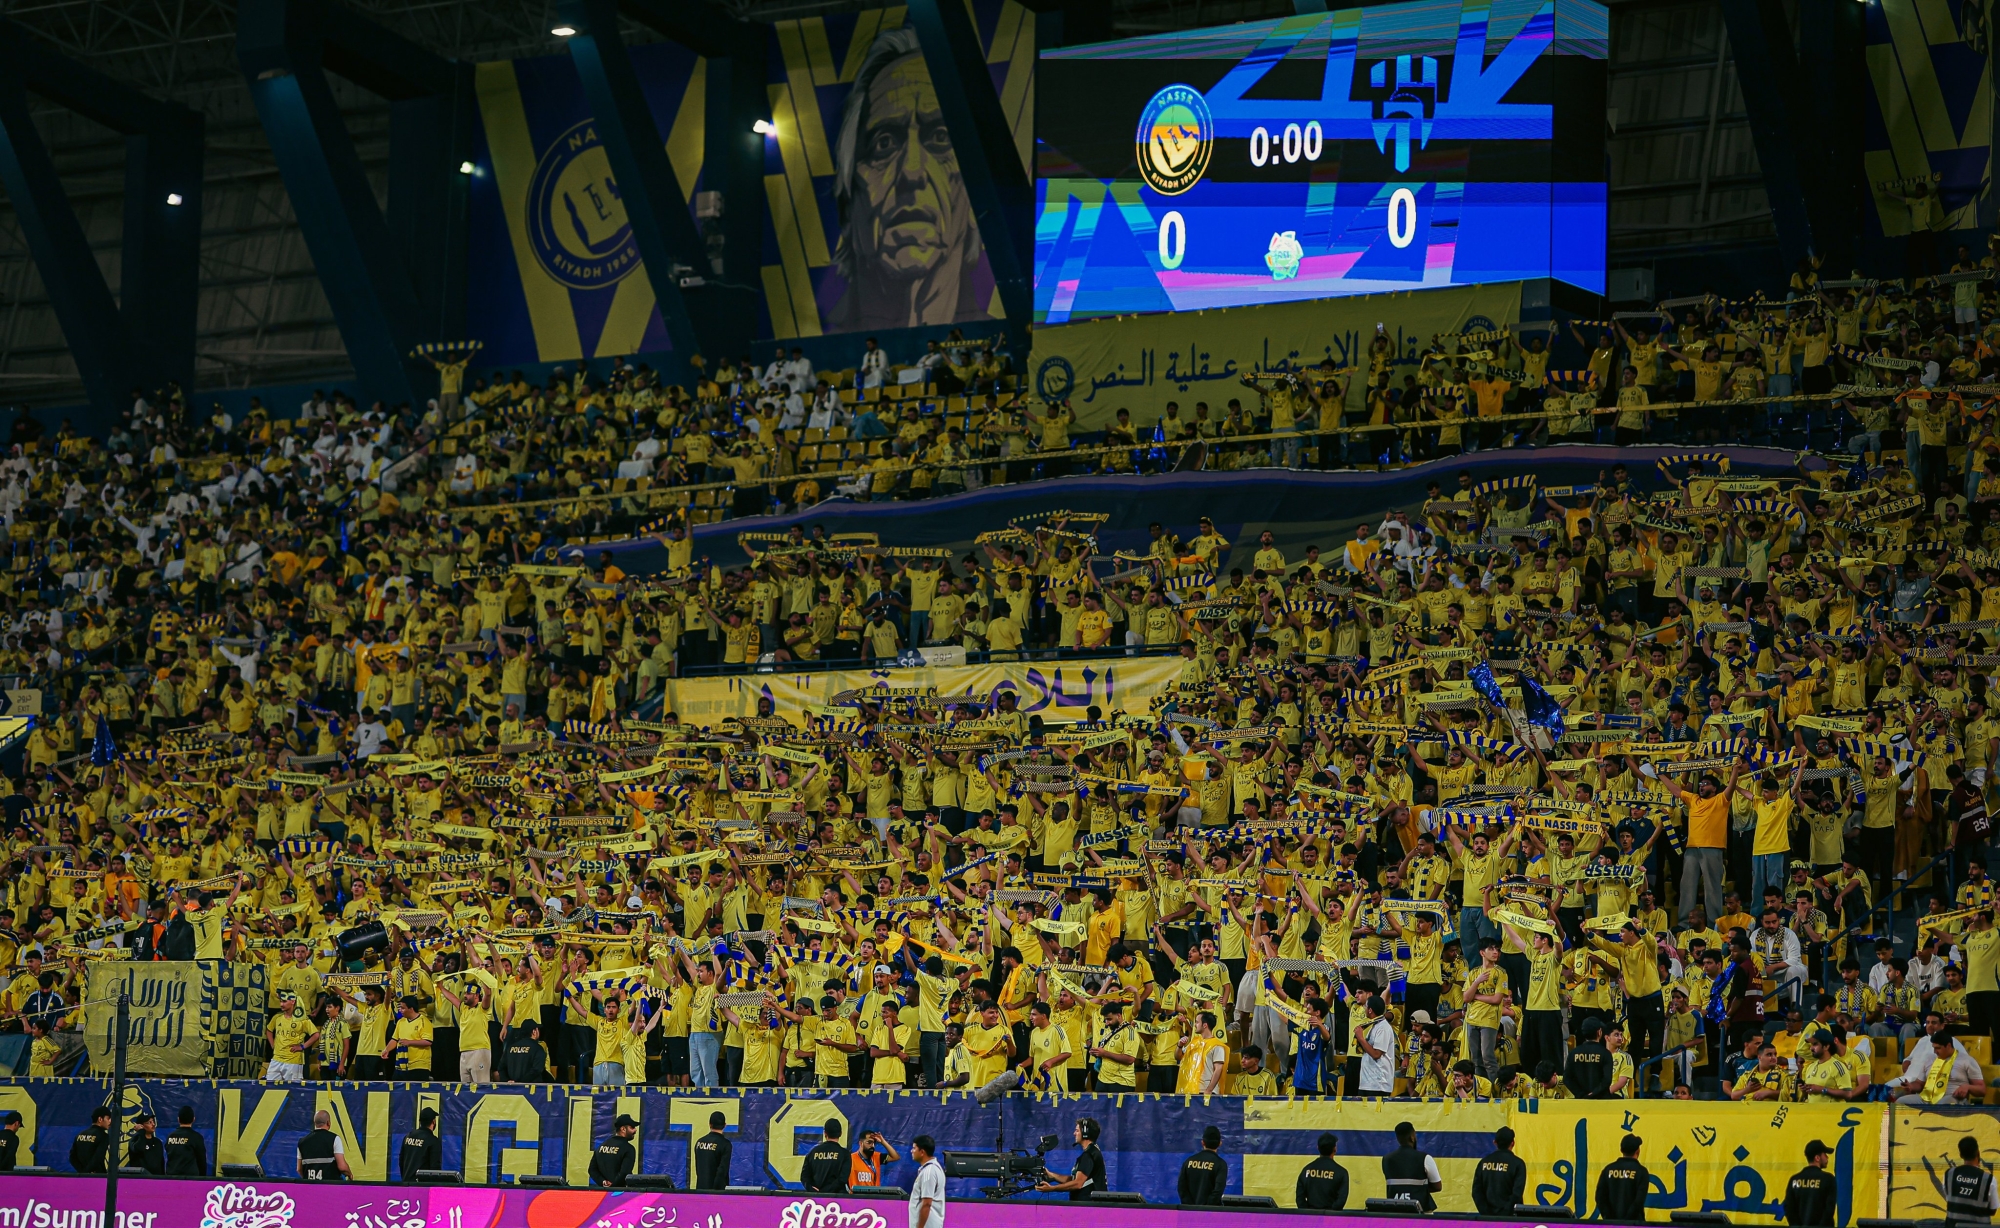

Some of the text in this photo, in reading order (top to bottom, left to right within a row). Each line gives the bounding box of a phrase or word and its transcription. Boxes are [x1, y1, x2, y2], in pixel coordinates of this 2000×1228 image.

[1157, 91, 1195, 108] NASSR
[1250, 120, 1323, 167] 0:00
[1150, 172, 1179, 189] RIYADH
[1387, 188, 1417, 249] 0
[1158, 210, 1186, 270] 0
[552, 253, 602, 279] RIYADH
[1468, 316, 1490, 328] NASSR
[1166, 343, 1238, 392] عقلية
[1083, 347, 1154, 402] النصر
[1487, 366, 1527, 381] NASSR
[1957, 385, 1980, 393] NASSR
[1865, 497, 1915, 519] ALNASSR
[1644, 514, 1690, 531] NASSR
[898, 547, 937, 557] ALNASSR
[1402, 658, 1419, 668] النصر
[871, 687, 920, 696] ALNASSR
[1179, 683, 1209, 692] NASS
[1435, 692, 1463, 700] Tarshid
[822, 706, 846, 715] Tarshid
[1607, 717, 1639, 726] النصر
[1721, 713, 1754, 723] Al Nassr
[1821, 720, 1855, 731] Al Nassr
[364, 729, 371, 739] 7
[1088, 733, 1118, 747] Al Nassr
[1629, 745, 1647, 753] وفخر
[1662, 743, 1685, 751] النصر
[783, 750, 810, 762] Al Nassr
[472, 775, 511, 786] NASSR
[1607, 790, 1663, 802] ALNASSR
[1538, 799, 1585, 811] ALNASSR
[451, 826, 478, 836] Al Nassr
[1527, 818, 1599, 833] AL NASSR 1955
[1082, 826, 1133, 847] NASSR
[990, 842, 1011, 851] Nassr
[439, 853, 480, 863] NASSR
[672, 856, 700, 865] Al Nassr
[63, 869, 88, 877] NASSR
[402, 863, 454, 872] ALNASSR
[1584, 865, 1634, 878] NASSR
[430, 883, 446, 892] وفخر
[458, 879, 474, 888] النصر
[1075, 877, 1107, 887] النصر
[454, 911, 470, 919] Nassr
[1518, 917, 1534, 928] Nassr
[73, 923, 125, 945] NASSR
[262, 938, 299, 949] NASSR
[330, 975, 380, 984] NASSR TILL DIE
[1060, 977, 1071, 986] Al
[1186, 986, 1198, 995] Al
[938, 992, 948, 1010] 7
[1134, 1021, 1169, 1034] Al Nassr
[509, 1046, 531, 1054] POLICE
[1574, 1053, 1601, 1063] POLICE
[1770, 1104, 1789, 1129] 1955
[168, 1136, 189, 1146] POLICE
[405, 1137, 424, 1147] POLICE
[696, 1141, 717, 1151] POLICE
[599, 1145, 619, 1154] POLICE
[813, 1151, 838, 1160] POLICE
[1187, 1160, 1214, 1171] POLICE
[1482, 1161, 1508, 1172] POLICE
[307, 1168, 323, 1180] 194
[1305, 1169, 1334, 1180] POLICE
[1608, 1169, 1636, 1180] POLICE
[1956, 1174, 1979, 1185] Guard
[1792, 1178, 1821, 1189] POLICE
[1959, 1186, 1973, 1196] 227
[386, 1200, 420, 1220] روح
[641, 1207, 677, 1226] روح
